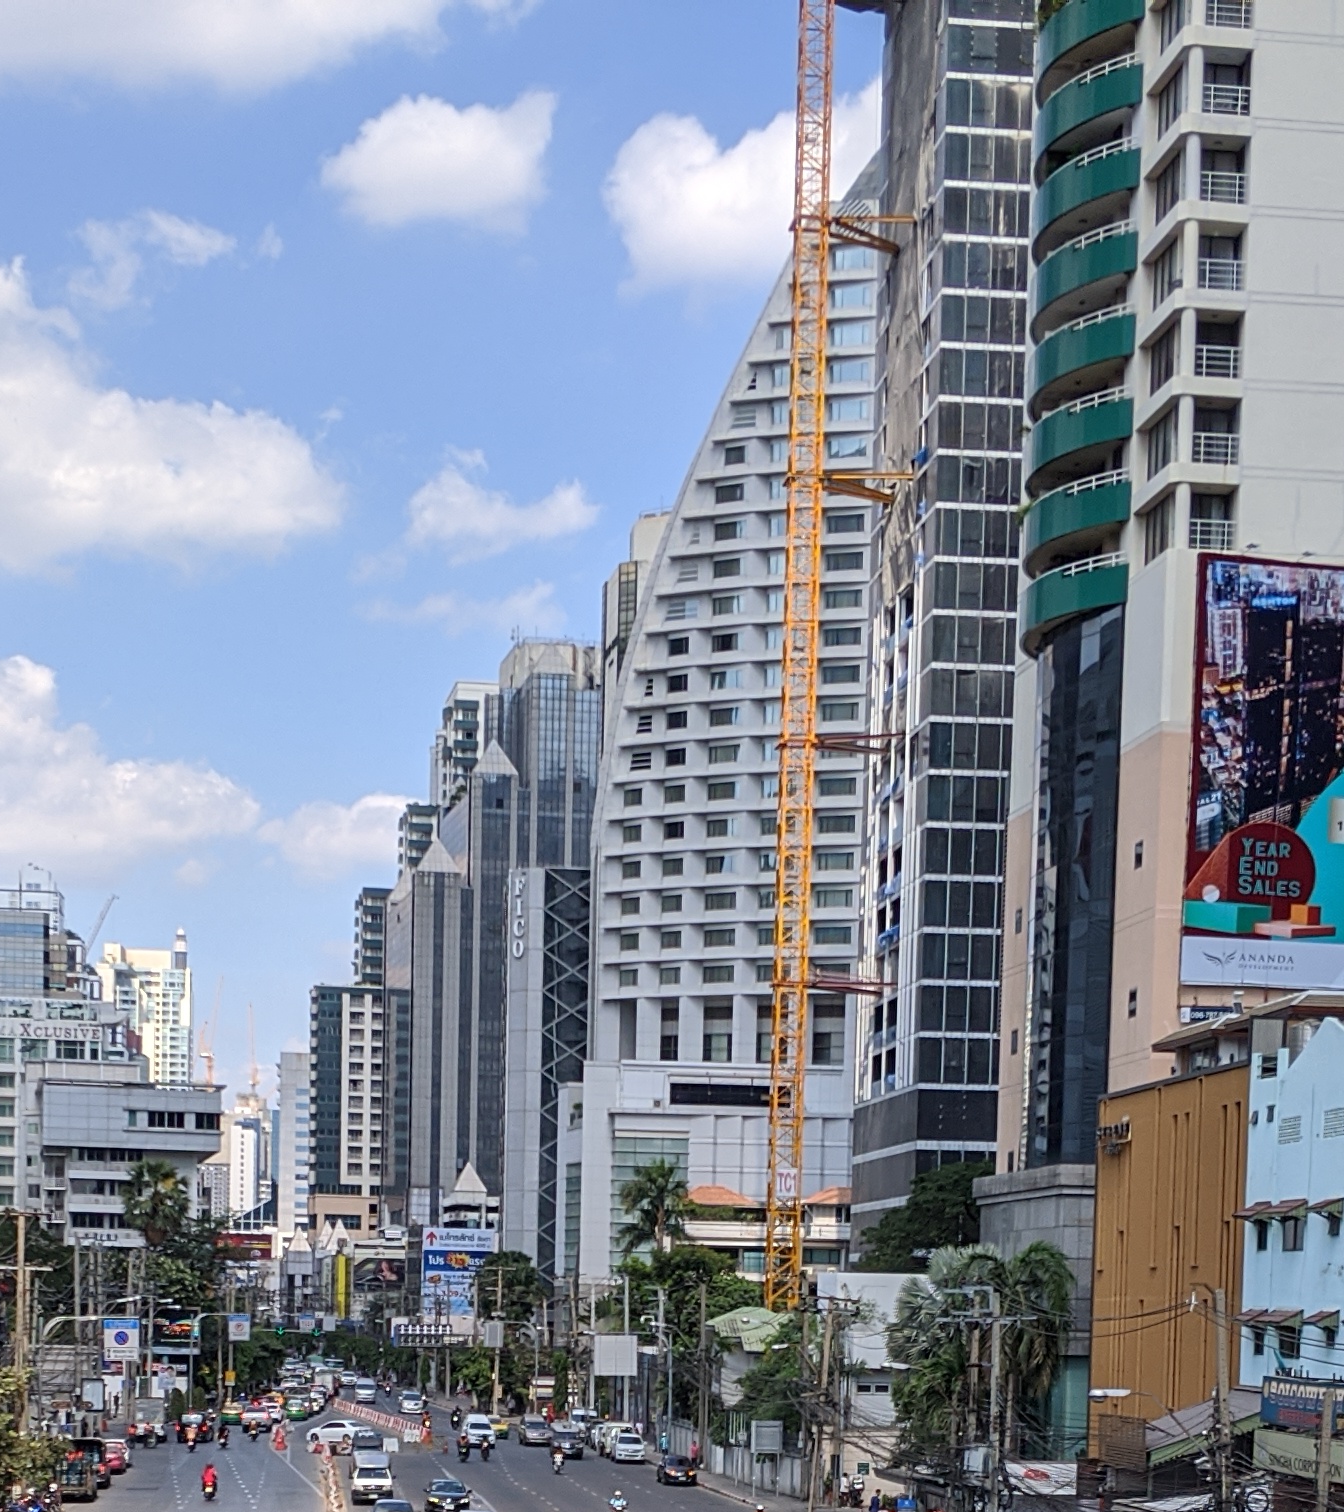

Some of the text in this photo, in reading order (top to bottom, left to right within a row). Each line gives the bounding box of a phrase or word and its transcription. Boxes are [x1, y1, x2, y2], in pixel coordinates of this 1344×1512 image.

[1242, 837, 1291, 858] YEAR
[1239, 857, 1279, 876] END
[1238, 876, 1301, 898] SALES
[512, 877, 526, 959] FICO
[1239, 953, 1294, 964] ANANDA
